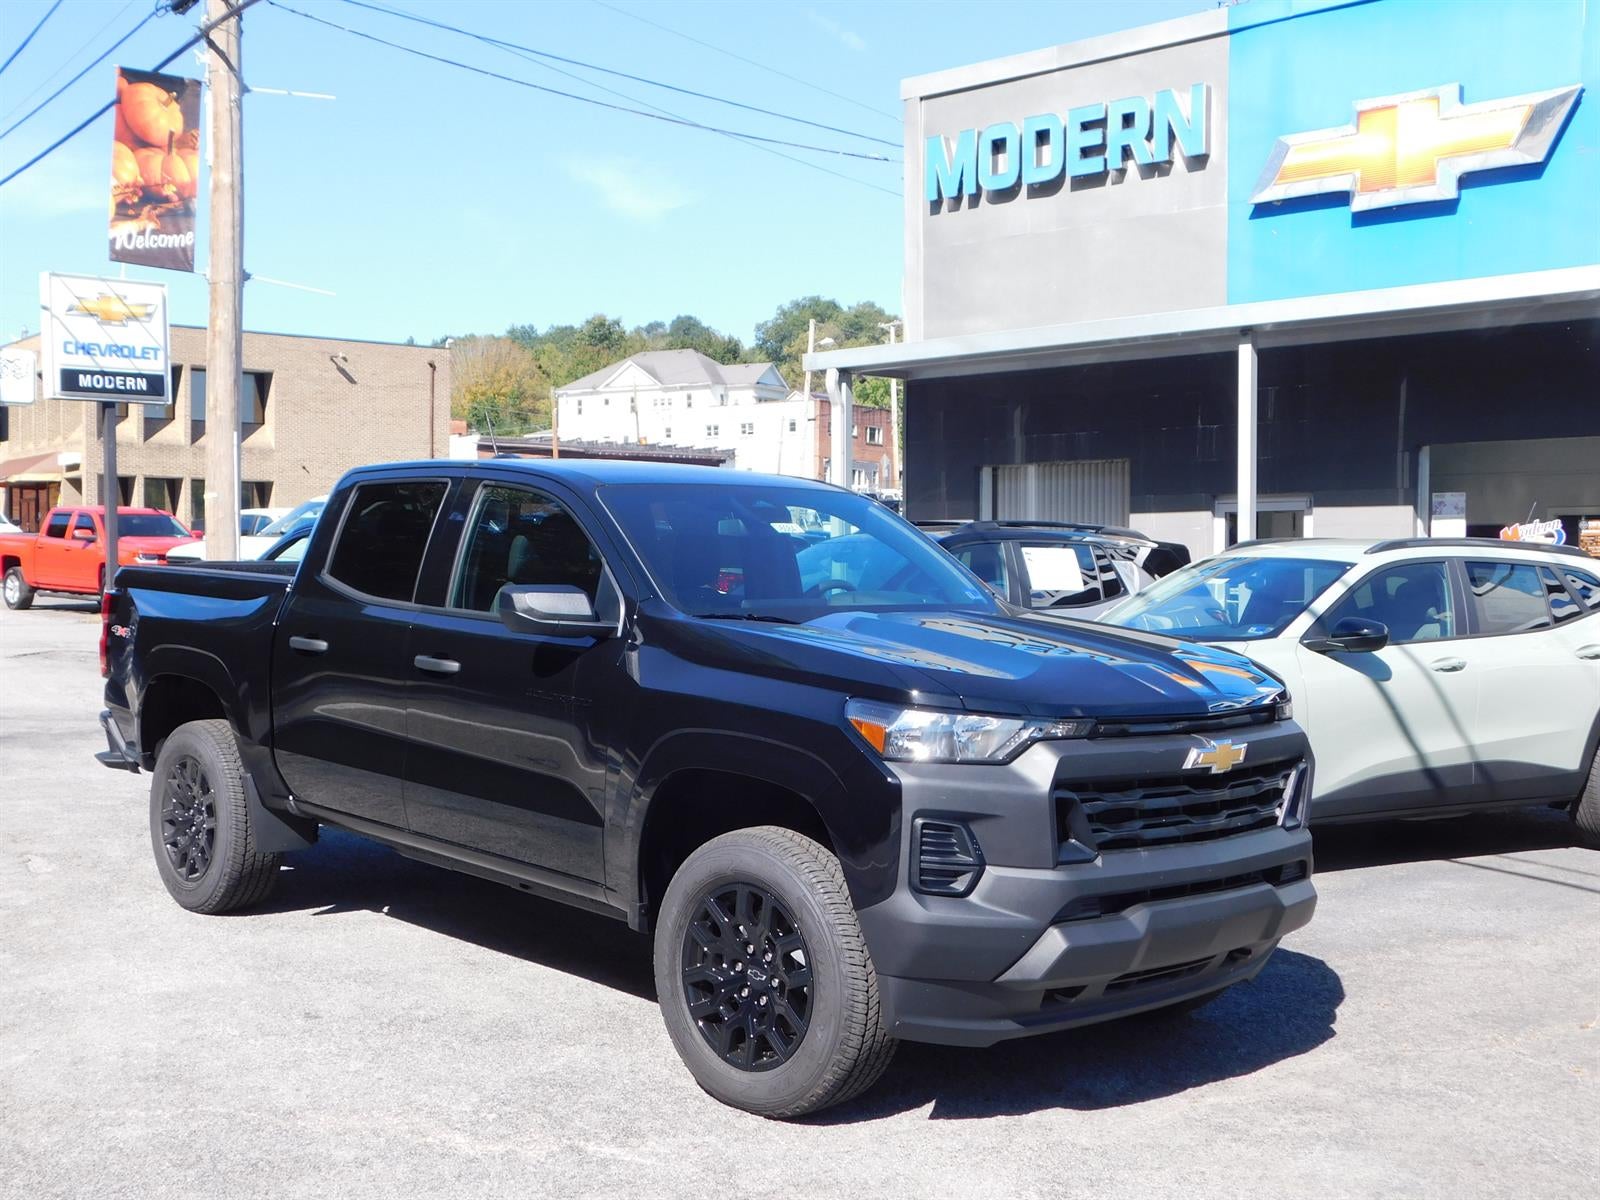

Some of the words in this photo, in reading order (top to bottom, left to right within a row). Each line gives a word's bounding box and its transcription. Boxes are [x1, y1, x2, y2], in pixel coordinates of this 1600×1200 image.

[925, 82, 1209, 204] MODERN
[110, 226, 194, 250] Welcome
[63, 341, 160, 360] CHEVROLET
[78, 373, 147, 391] MODERN
